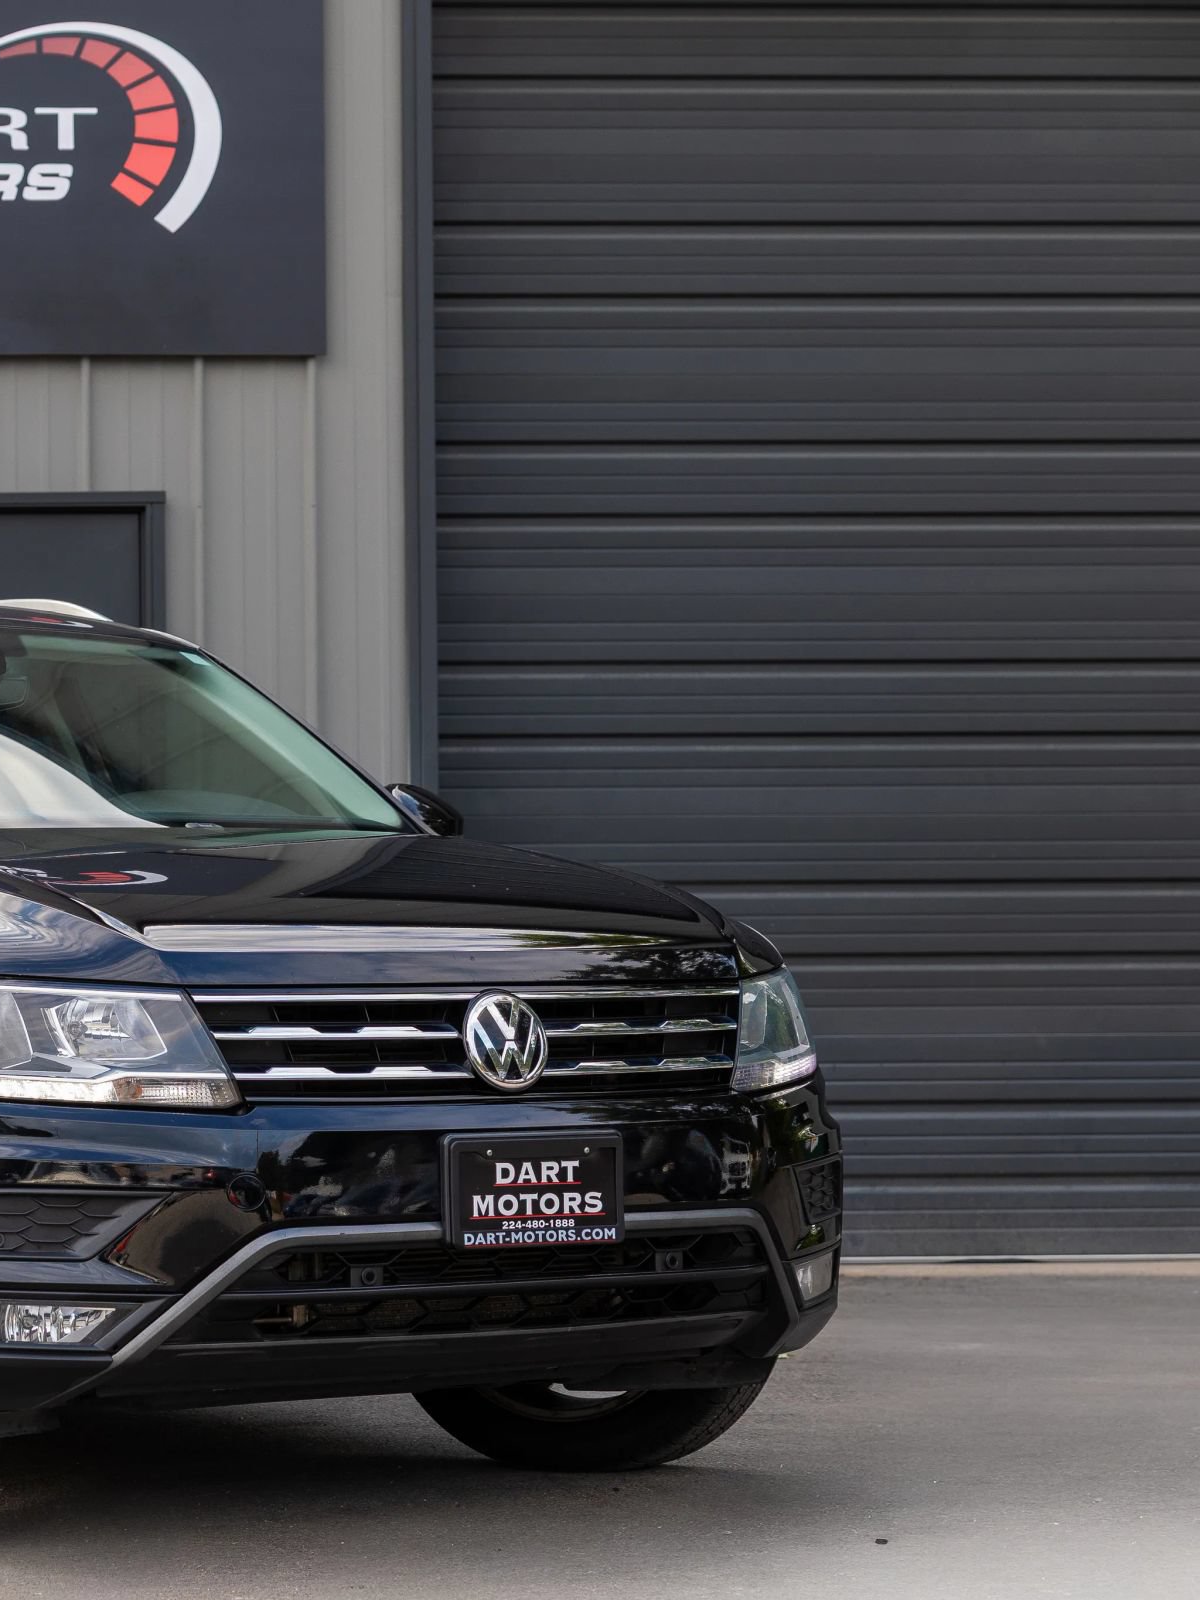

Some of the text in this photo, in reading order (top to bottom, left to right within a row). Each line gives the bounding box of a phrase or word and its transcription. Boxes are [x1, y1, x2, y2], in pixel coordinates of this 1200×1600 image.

[465, 990, 547, 1091] VW
[495, 1160, 580, 1185] DART
[472, 1191, 603, 1217] MOTORS
[464, 1227, 616, 1246] DART-MOTORS.COM
[502, 1219, 575, 1230] 224-480-1888
